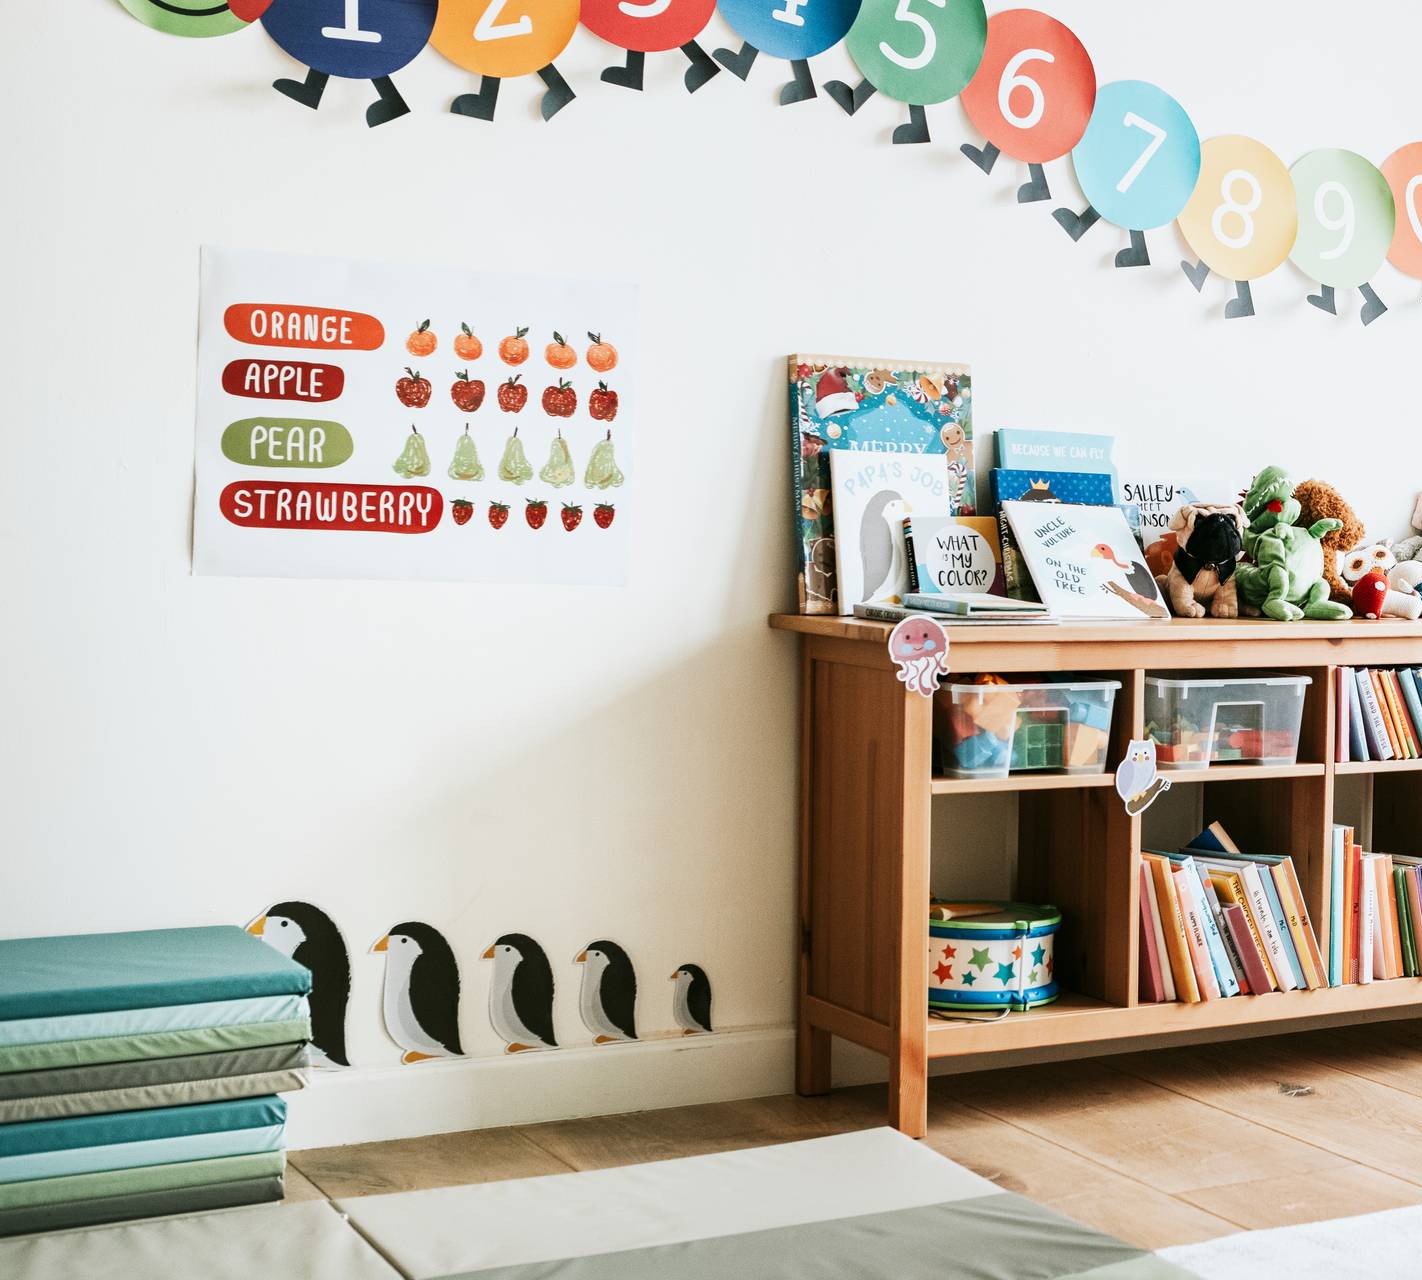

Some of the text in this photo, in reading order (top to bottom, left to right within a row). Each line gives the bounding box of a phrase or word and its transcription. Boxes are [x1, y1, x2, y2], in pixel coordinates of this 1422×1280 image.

[879, 0, 946, 70] 5
[997, 48, 1055, 129] 6
[1115, 111, 1168, 194] 7
[1211, 169, 1263, 250] 8
[1312, 180, 1356, 261] 9
[250, 309, 353, 345] ORANGE
[244, 362, 324, 398] APPLE
[250, 426, 326, 463] PEAR
[1011, 443, 1105, 460] BECAUSE WE CAN FLY
[844, 460, 944, 497] PAPA'S JOB
[1124, 484, 1173, 502] SALLEY
[233, 488, 433, 527] STRAWBERRY
[1034, 515, 1066, 539] UNCLE
[936, 535, 979, 551] WHAT
[1041, 525, 1076, 549] VULTURE
[951, 553, 973, 569] MY
[1045, 557, 1088, 576] ON THE
[938, 570, 987, 587] COLOR?
[1055, 570, 1081, 583] OLD
[1055, 579, 1086, 595] TREE
[1232, 880, 1242, 897] THE
